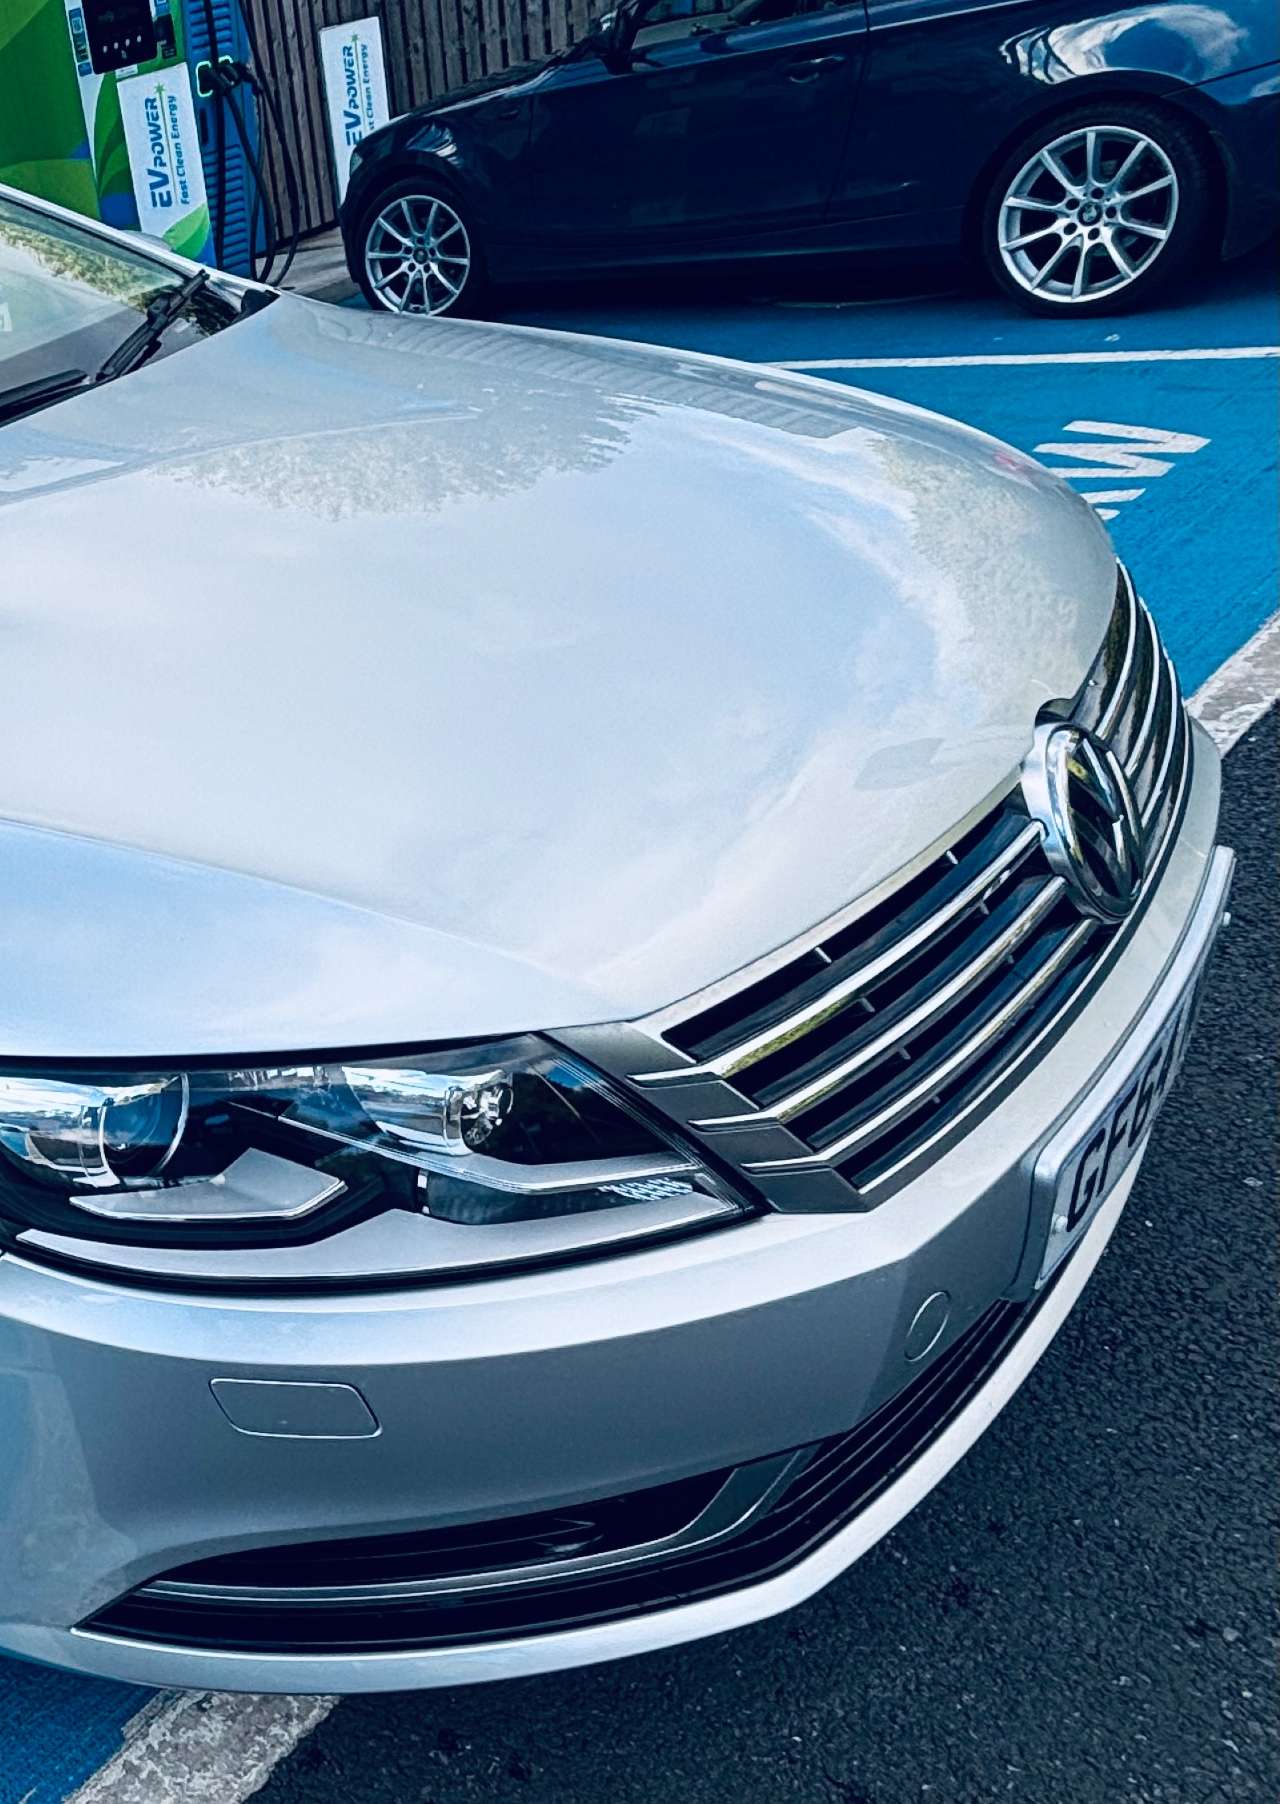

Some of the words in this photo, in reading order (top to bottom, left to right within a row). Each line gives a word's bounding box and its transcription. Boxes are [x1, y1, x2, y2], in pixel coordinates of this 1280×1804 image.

[342, 45, 359, 110] POWER
[361, 43, 371, 84] Energy
[167, 95, 180, 139] Energy
[366, 86, 374, 119] Clean
[144, 97, 167, 168] POWER
[343, 109, 362, 146] EV
[175, 142, 186, 177] Clean
[146, 168, 173, 208] EV
[179, 178, 190, 205] Fast
